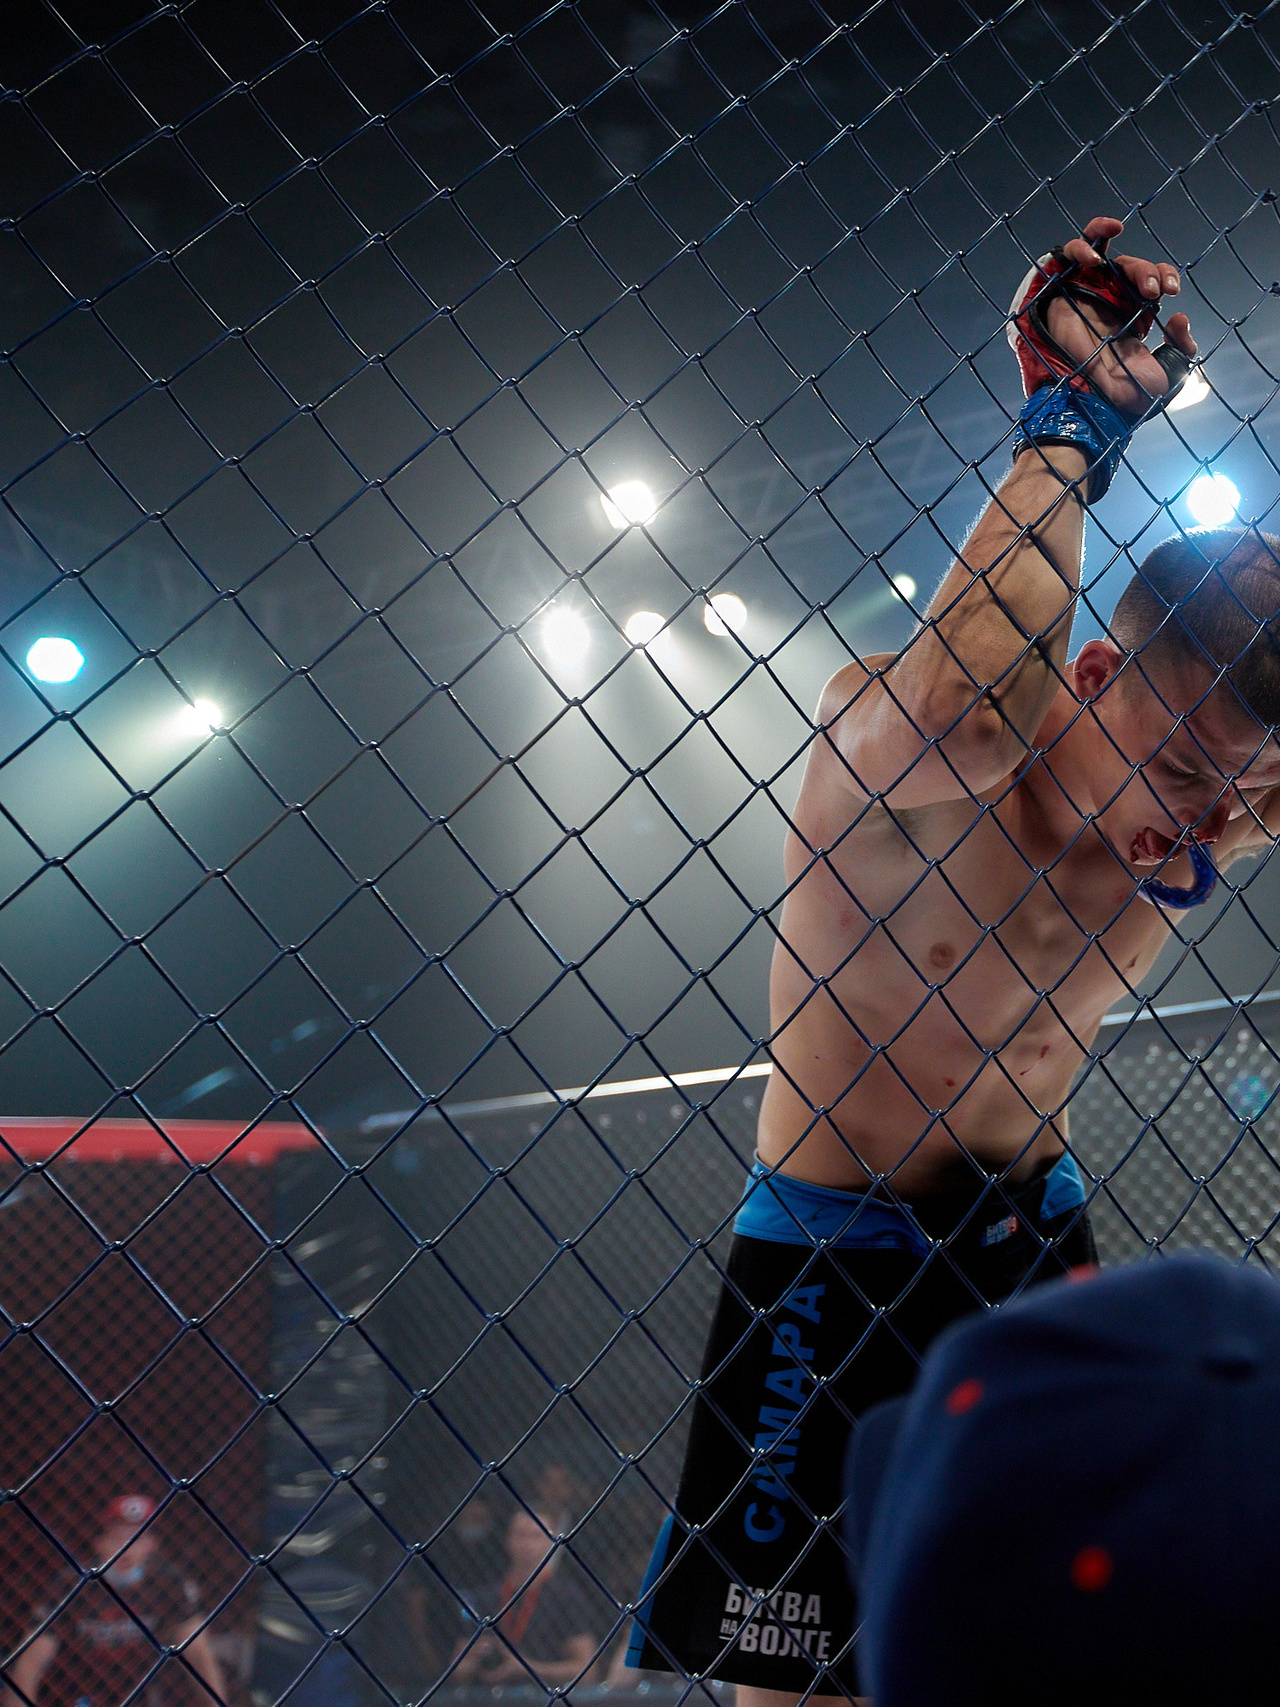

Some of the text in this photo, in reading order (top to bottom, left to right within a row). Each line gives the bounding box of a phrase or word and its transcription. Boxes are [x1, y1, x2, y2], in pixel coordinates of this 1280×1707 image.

[743, 1283, 827, 1543] САМАРА
[724, 1582, 821, 1625] БИТВА
[719, 1618, 832, 1660] НА ВОЛГЕ
